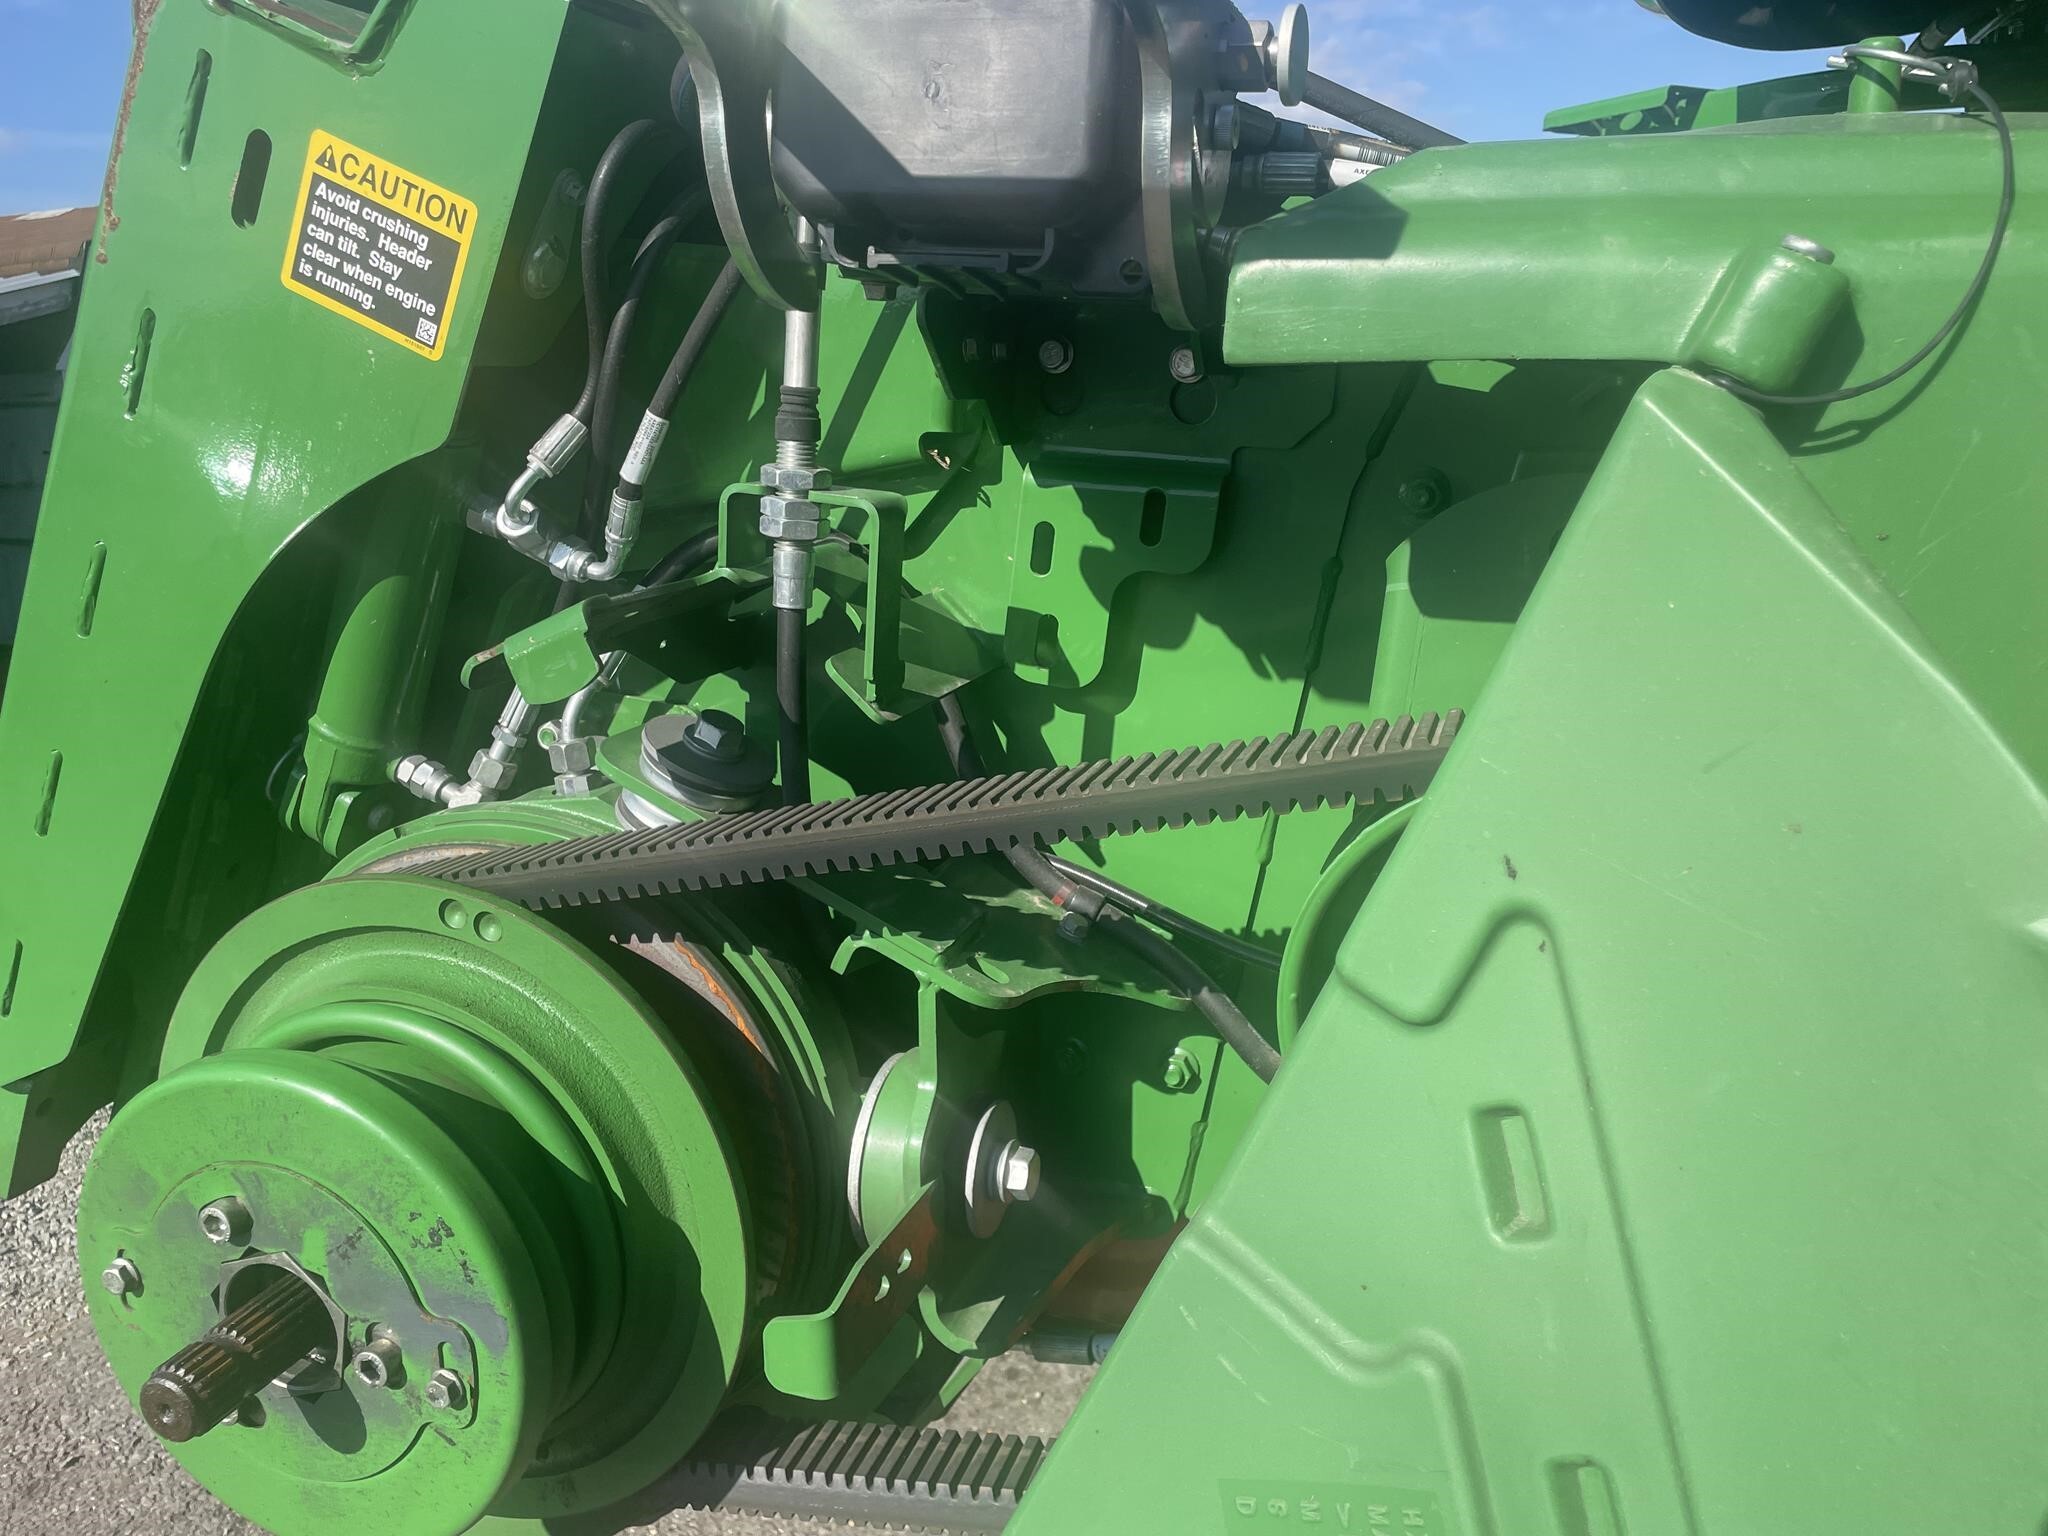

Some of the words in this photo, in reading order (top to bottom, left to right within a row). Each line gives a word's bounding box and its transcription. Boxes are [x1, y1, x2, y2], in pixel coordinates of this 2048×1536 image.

[314, 182, 360, 215] Avoid
[361, 205, 429, 251] crushing
[340, 153, 468, 234] CAUTION
[306, 223, 335, 247] can
[337, 233, 361, 258] tilt.
[368, 250, 403, 281] Stay
[311, 201, 370, 242] injuries.
[377, 233, 433, 271] Header
[298, 258, 313, 277] is
[315, 268, 376, 310] running.
[303, 242, 340, 269] clear
[342, 261, 382, 291] when
[384, 283, 436, 317] engine
